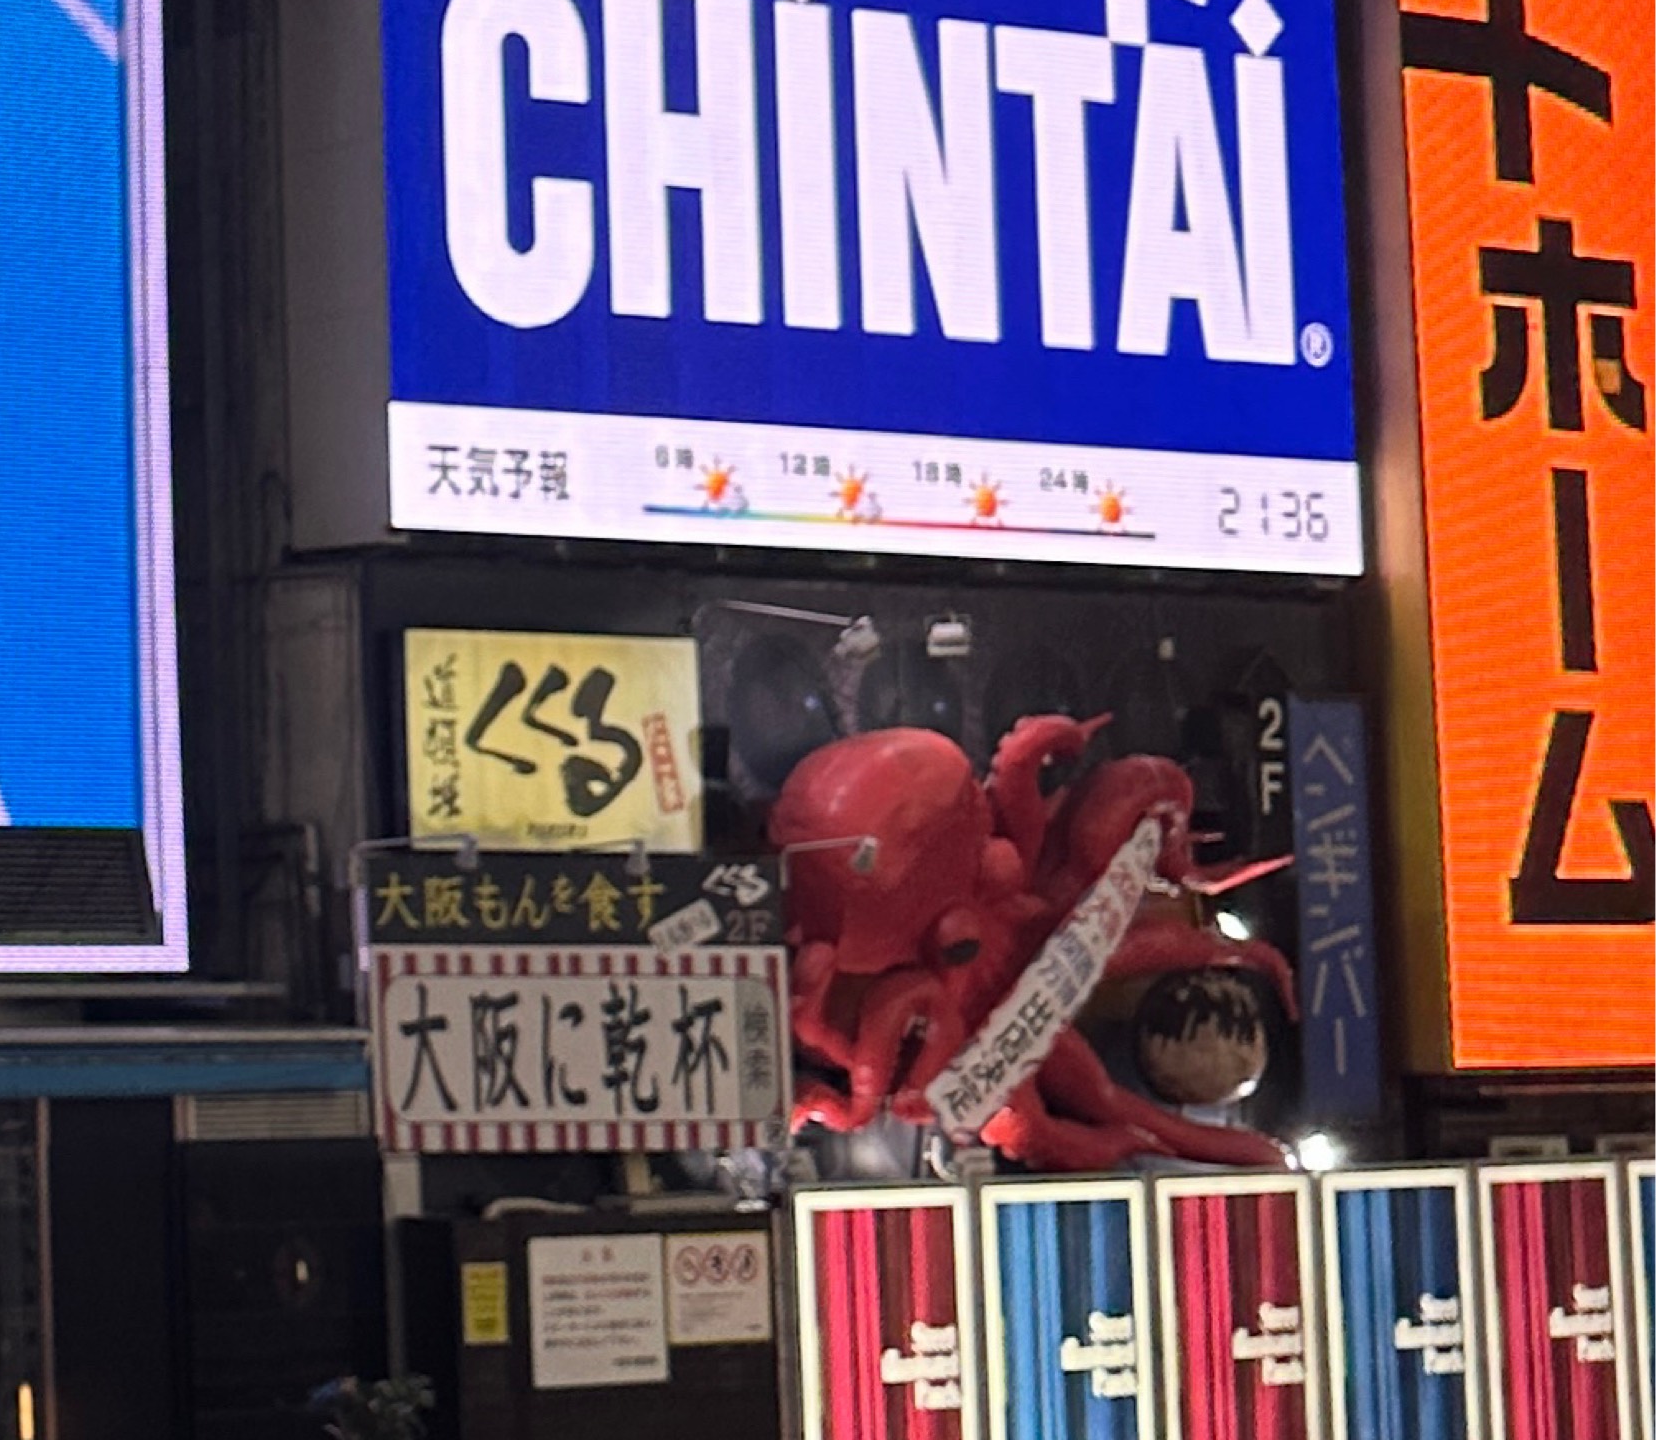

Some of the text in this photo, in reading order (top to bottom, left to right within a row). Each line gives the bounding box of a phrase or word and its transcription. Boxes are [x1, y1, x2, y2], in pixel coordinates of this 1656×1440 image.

[427, 445, 569, 500] 天気予報
[465, 660, 642, 816] くくる
[375, 872, 665, 932] 大阪もんを食す
[1302, 732, 1367, 1076] ペンギンバー
[399, 983, 728, 1116] 大阪に乾杯
